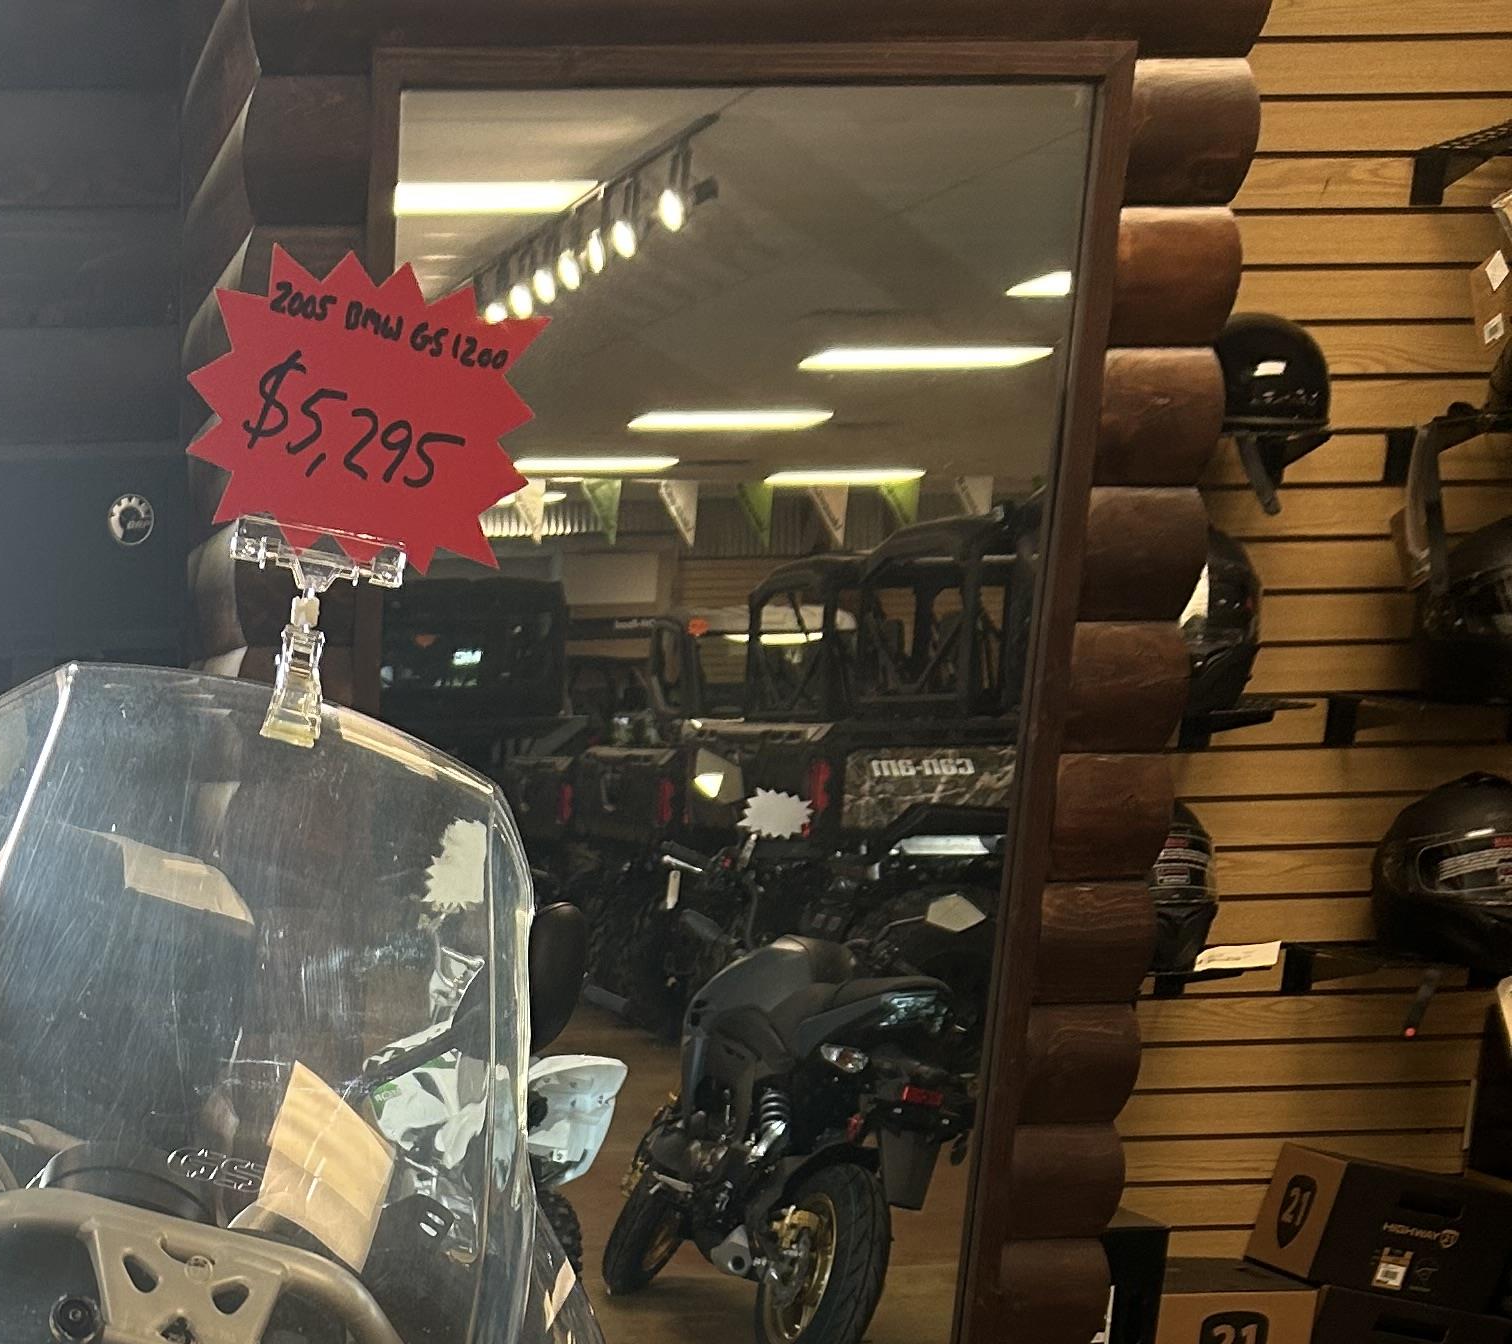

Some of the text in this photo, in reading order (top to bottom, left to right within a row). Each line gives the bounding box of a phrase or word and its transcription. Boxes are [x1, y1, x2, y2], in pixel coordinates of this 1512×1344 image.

[270, 282, 337, 321] 2005
[345, 301, 404, 341] BMW
[243, 350, 465, 488] $5,295
[1281, 1187, 1312, 1227] 21
